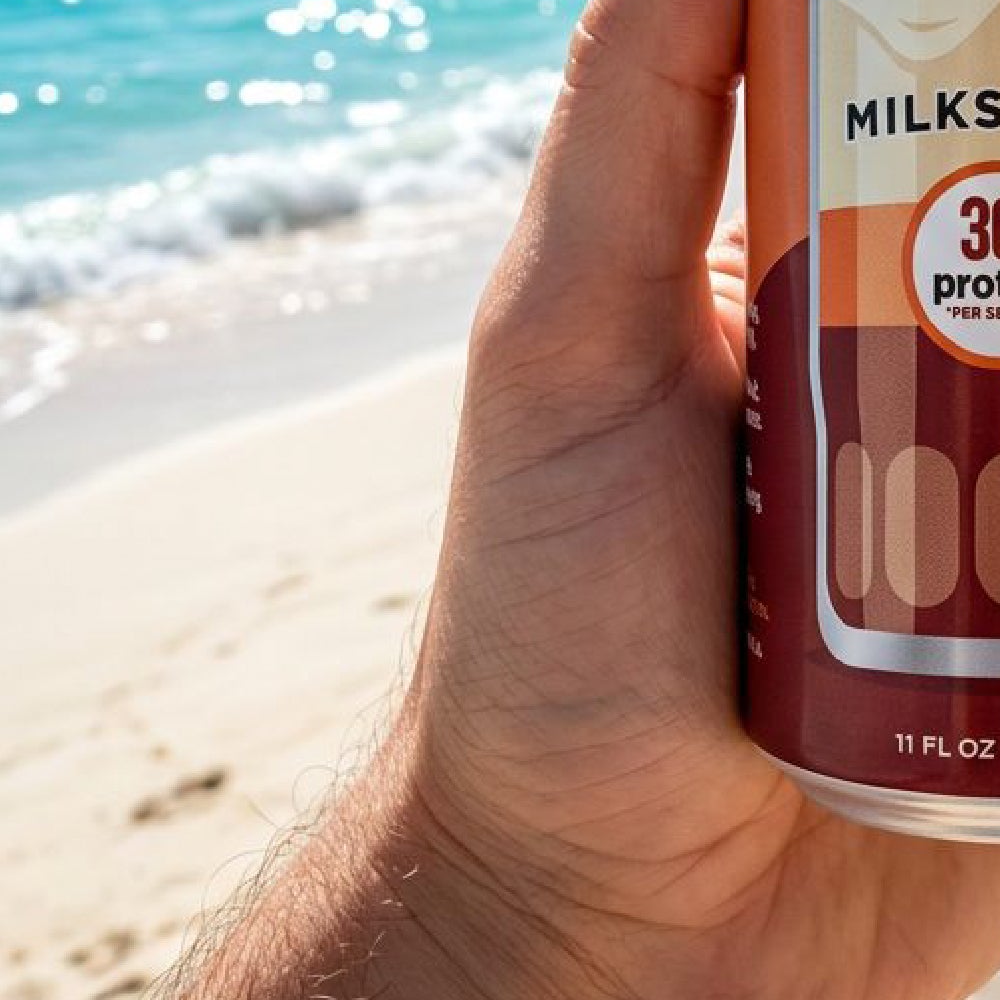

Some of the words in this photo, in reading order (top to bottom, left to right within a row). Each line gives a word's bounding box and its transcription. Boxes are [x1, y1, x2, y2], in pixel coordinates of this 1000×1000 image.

[895, 733, 914, 754] 11
[922, 735, 951, 757] FL
[957, 738, 996, 759] OZ
